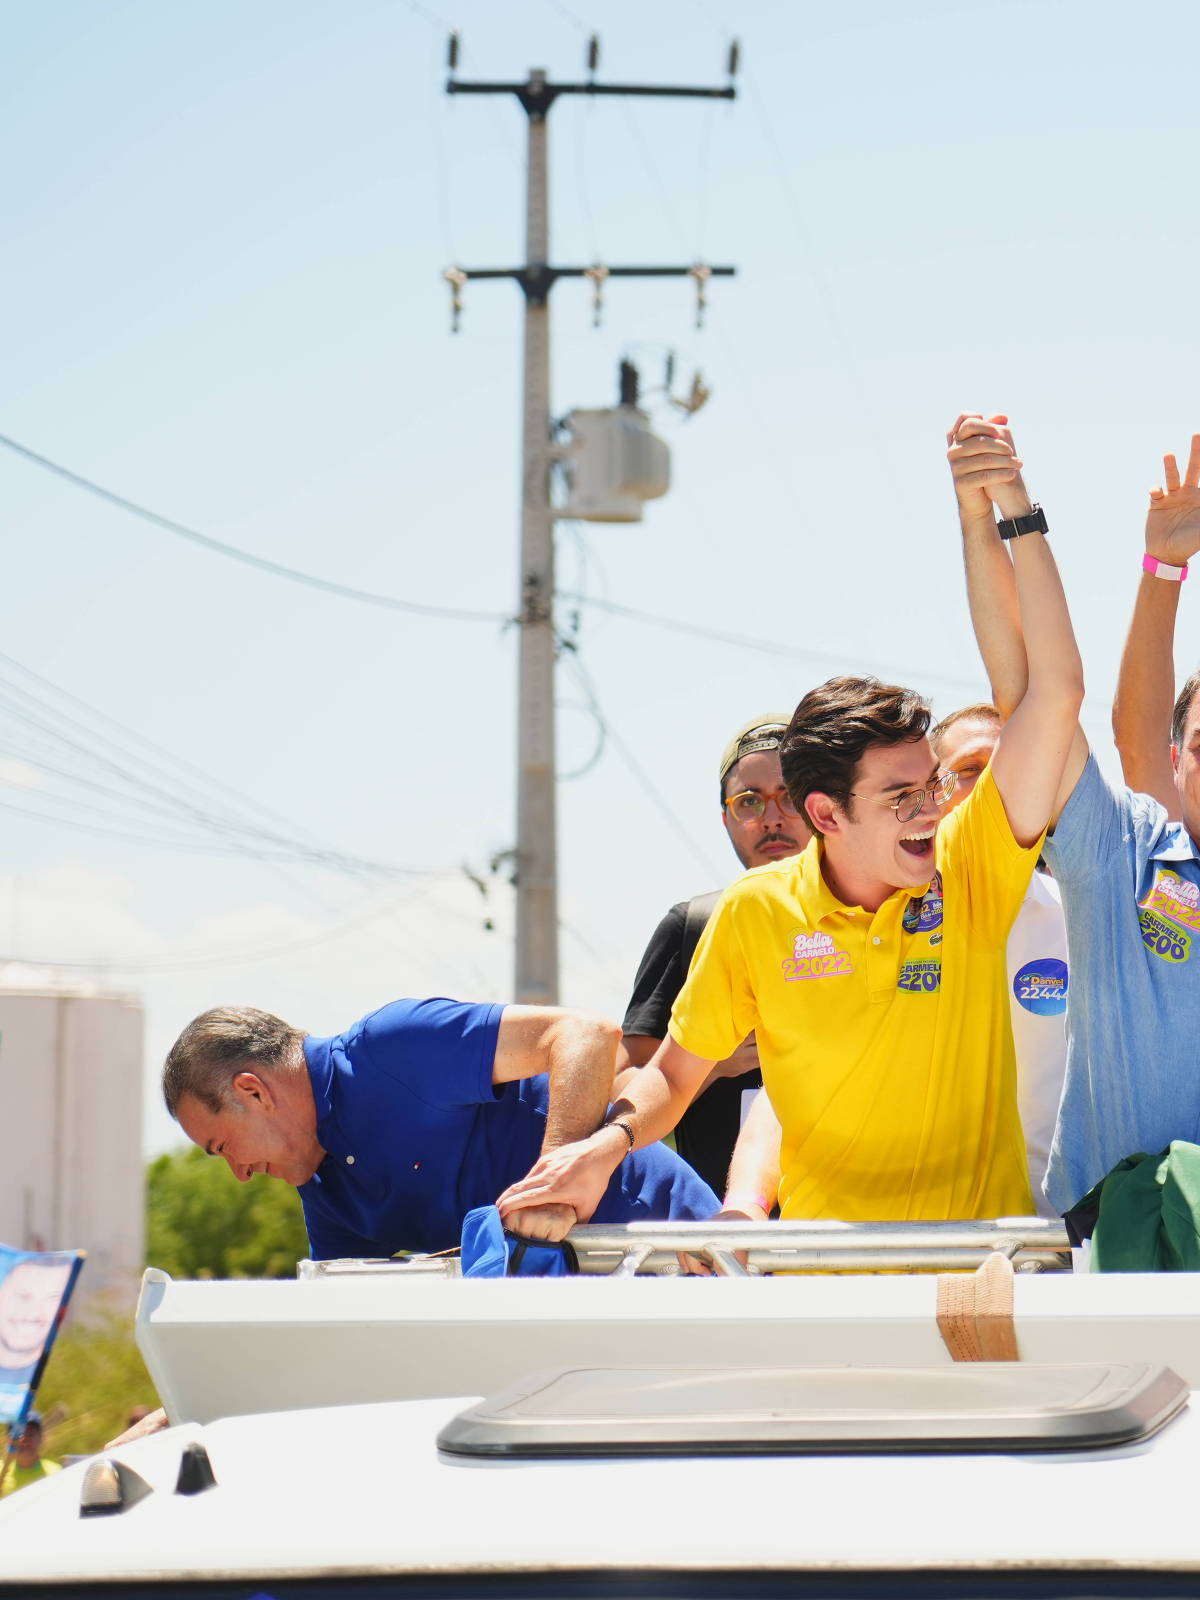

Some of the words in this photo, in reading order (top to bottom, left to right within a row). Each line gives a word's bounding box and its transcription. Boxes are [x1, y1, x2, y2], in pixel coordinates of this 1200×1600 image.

[1160, 876, 1200, 901] Bella
[1145, 911, 1187, 945] CARMELO
[794, 932, 834, 951] Bella
[795, 946, 835, 958] CARMELO
[783, 953, 852, 978] 22022
[900, 963, 941, 973] CARMEL
[898, 972, 941, 991] 220
